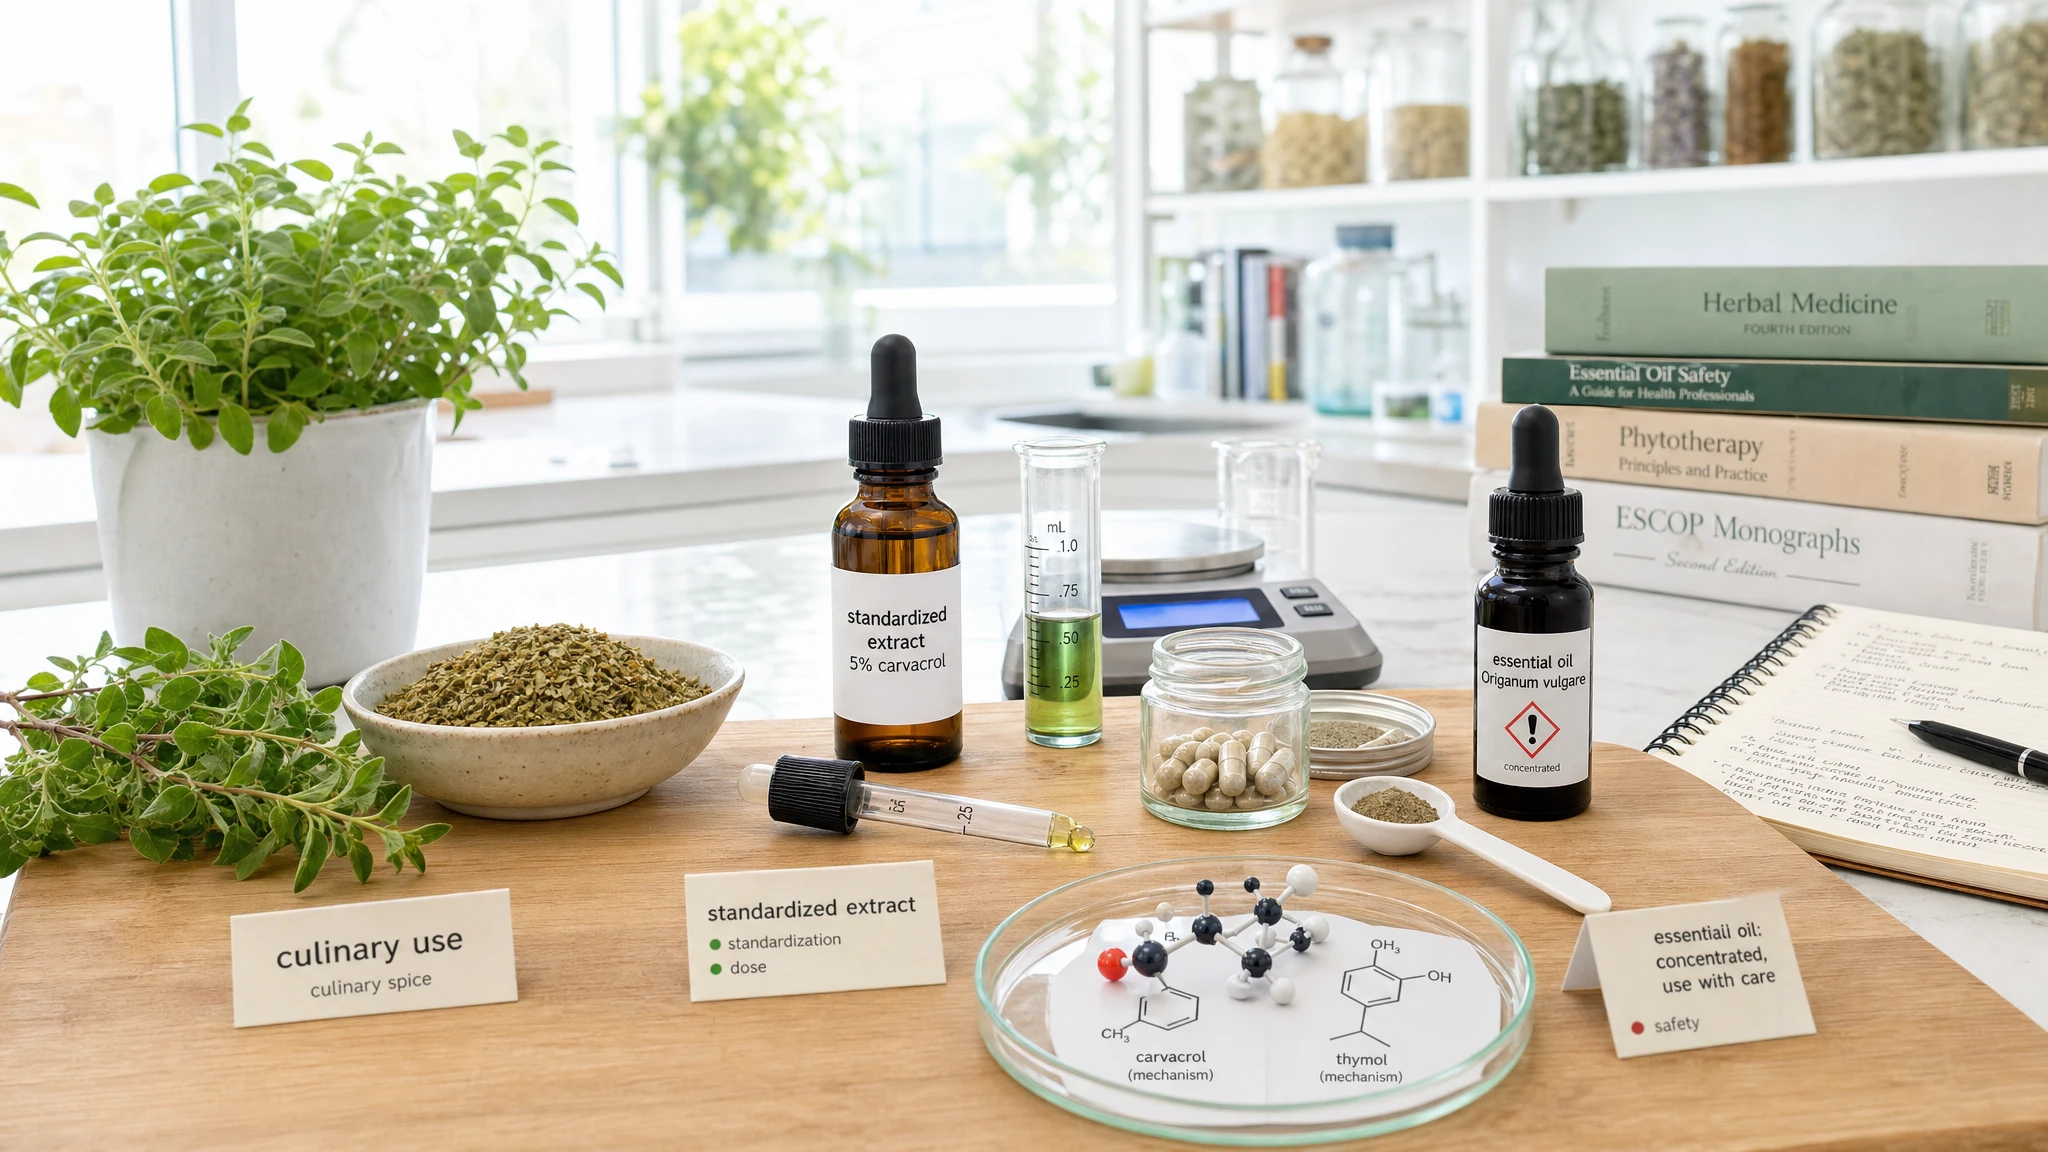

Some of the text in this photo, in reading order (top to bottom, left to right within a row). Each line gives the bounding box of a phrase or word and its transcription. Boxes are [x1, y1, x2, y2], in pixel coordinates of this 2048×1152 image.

[1703, 292, 1898, 315] Herbal Medicine
[1744, 323, 1851, 336] FOURTH EDITION
[1569, 363, 1731, 387] Essential Oil Safety
[1569, 385, 1755, 403] A Guide for Health Professionals
[1619, 426, 1763, 462] Phytotherapy
[1618, 457, 1768, 483] Principles and Practice
[1047, 521, 1066, 533] mL
[1616, 505, 1860, 558] ESCOP Monographs
[1664, 553, 1779, 579] Second Edition
[1059, 584, 1079, 597] .75
[847, 606, 947, 626] standardized
[867, 633, 925, 650] extract
[1059, 631, 1079, 644] .50
[850, 653, 946, 672] 5% carvacrol
[1493, 653, 1573, 669] essential oil
[1059, 675, 1080, 689] .25
[1481, 671, 1586, 690] Origanum vulgare
[1504, 763, 1560, 773] concentrated
[708, 897, 916, 922] standardized extract
[1737, 921, 1762, 938] oil:
[728, 933, 842, 950] standardization
[276, 932, 463, 969] culinary use
[1656, 946, 1768, 969] concentrated,
[730, 960, 767, 975] dose
[1427, 970, 1452, 983] OH
[1662, 971, 1776, 994] use with care
[310, 973, 432, 998] culinary spice
[1655, 1016, 1700, 1033] safety
[1136, 1050, 1207, 1063] carvacrol
[1336, 1053, 1388, 1068] thymol
[1128, 1069, 1214, 1082] (mechanism)
[1319, 1070, 1403, 1083] (mechanism)
